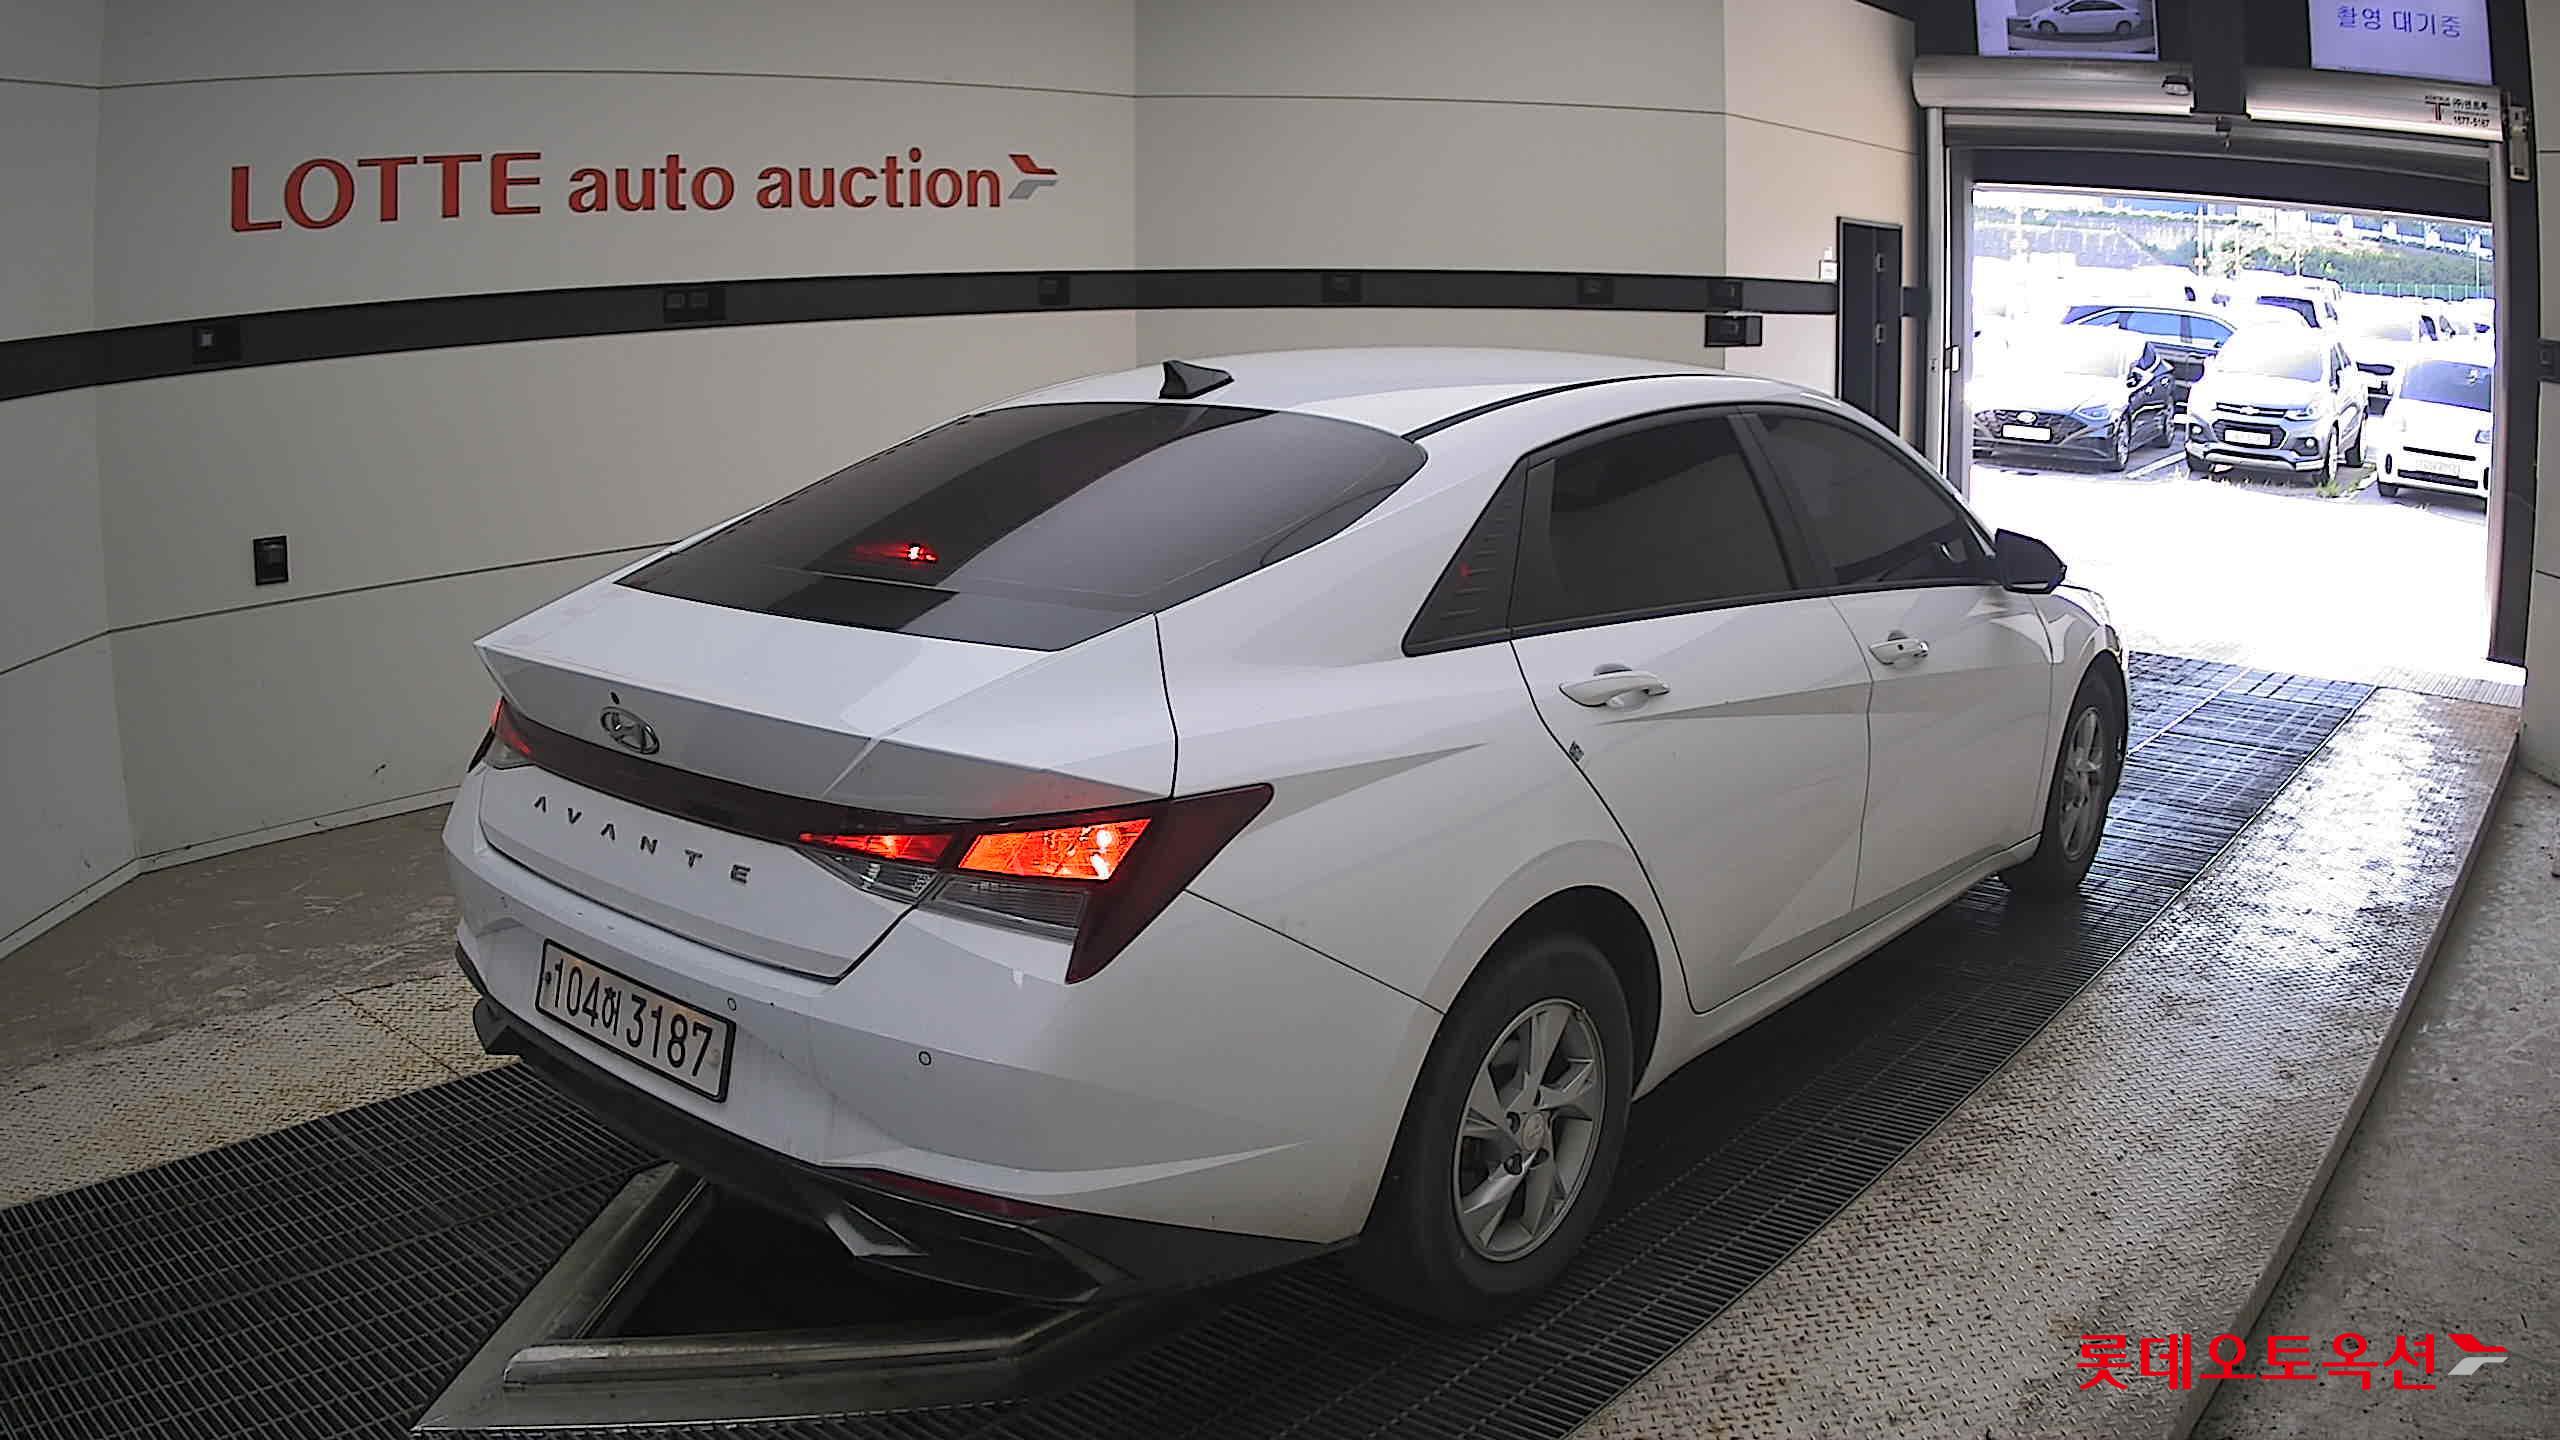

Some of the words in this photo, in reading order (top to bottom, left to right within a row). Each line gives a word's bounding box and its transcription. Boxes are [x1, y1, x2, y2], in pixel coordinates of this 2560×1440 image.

[2337, 6, 2381, 31] 촬영
[2393, 11, 2461, 38] 대기중
[231, 152, 541, 232] LOTTE
[568, 153, 734, 213] auto
[756, 147, 1001, 209] auction
[534, 796, 751, 884] AVANTE
